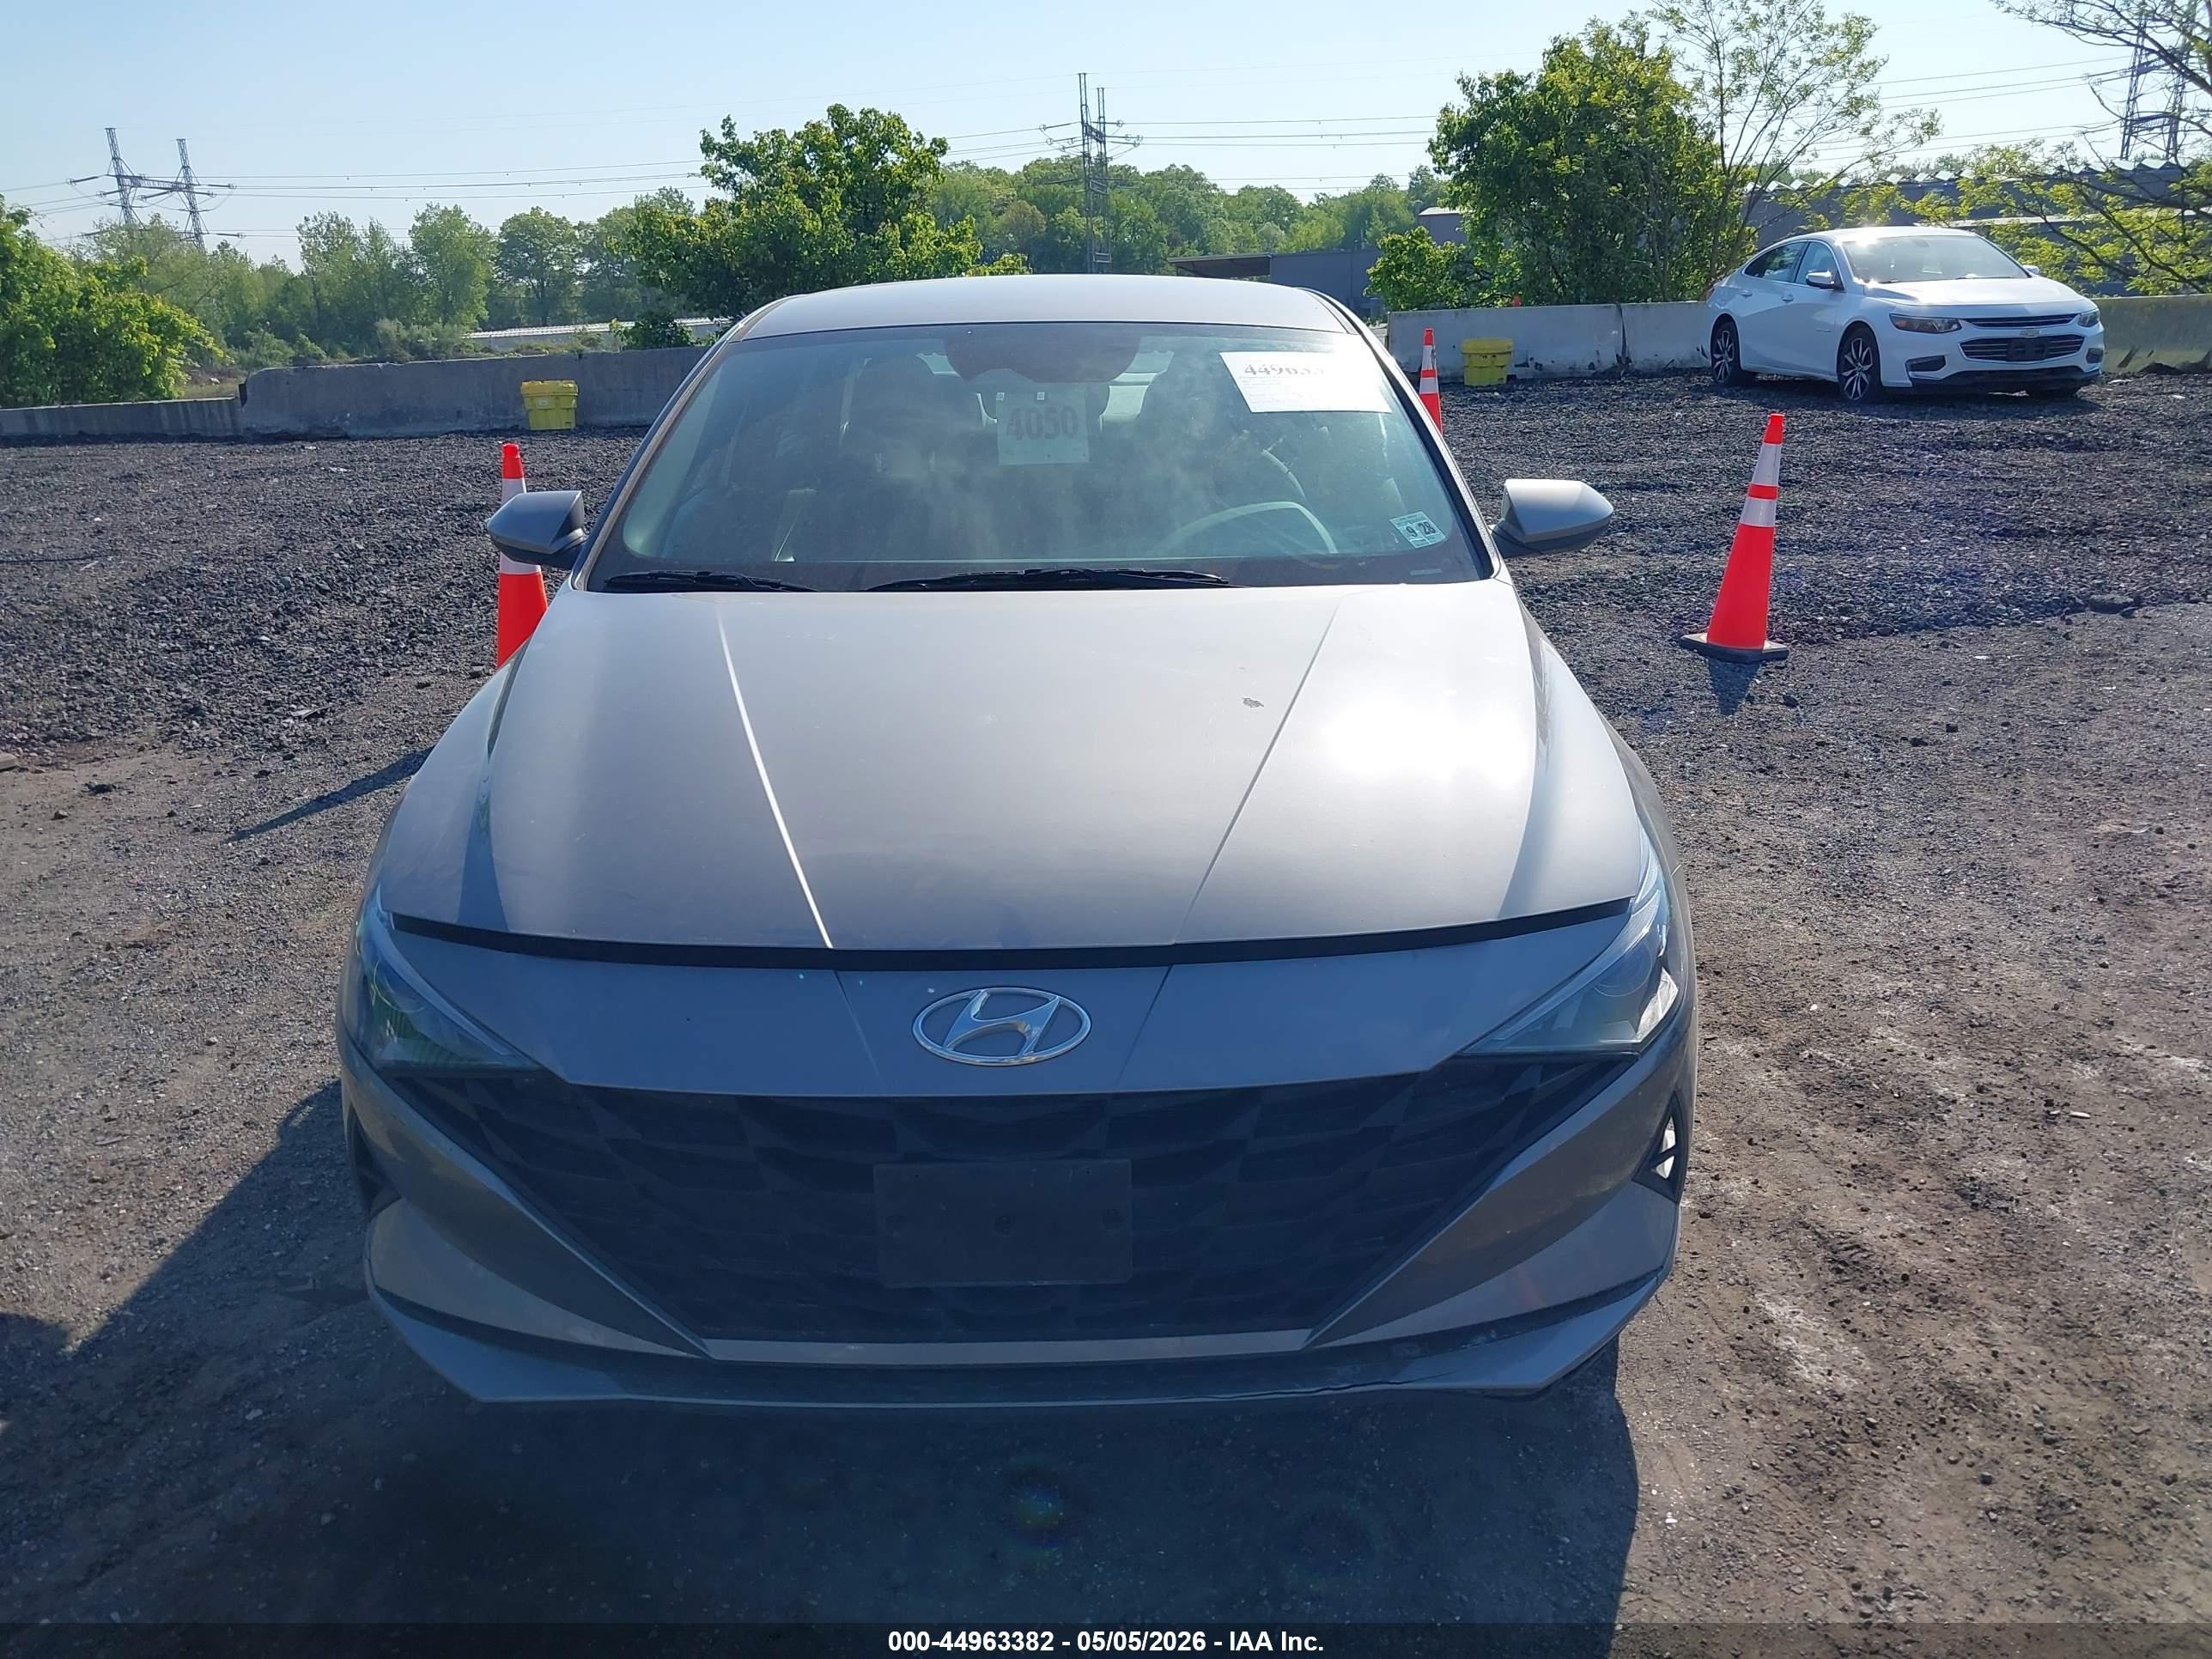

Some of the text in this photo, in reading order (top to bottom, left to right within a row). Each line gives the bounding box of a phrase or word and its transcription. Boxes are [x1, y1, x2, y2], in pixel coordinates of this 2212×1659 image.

[1006, 404, 1079, 441] 4050
[1406, 520, 1437, 538] 9 28
